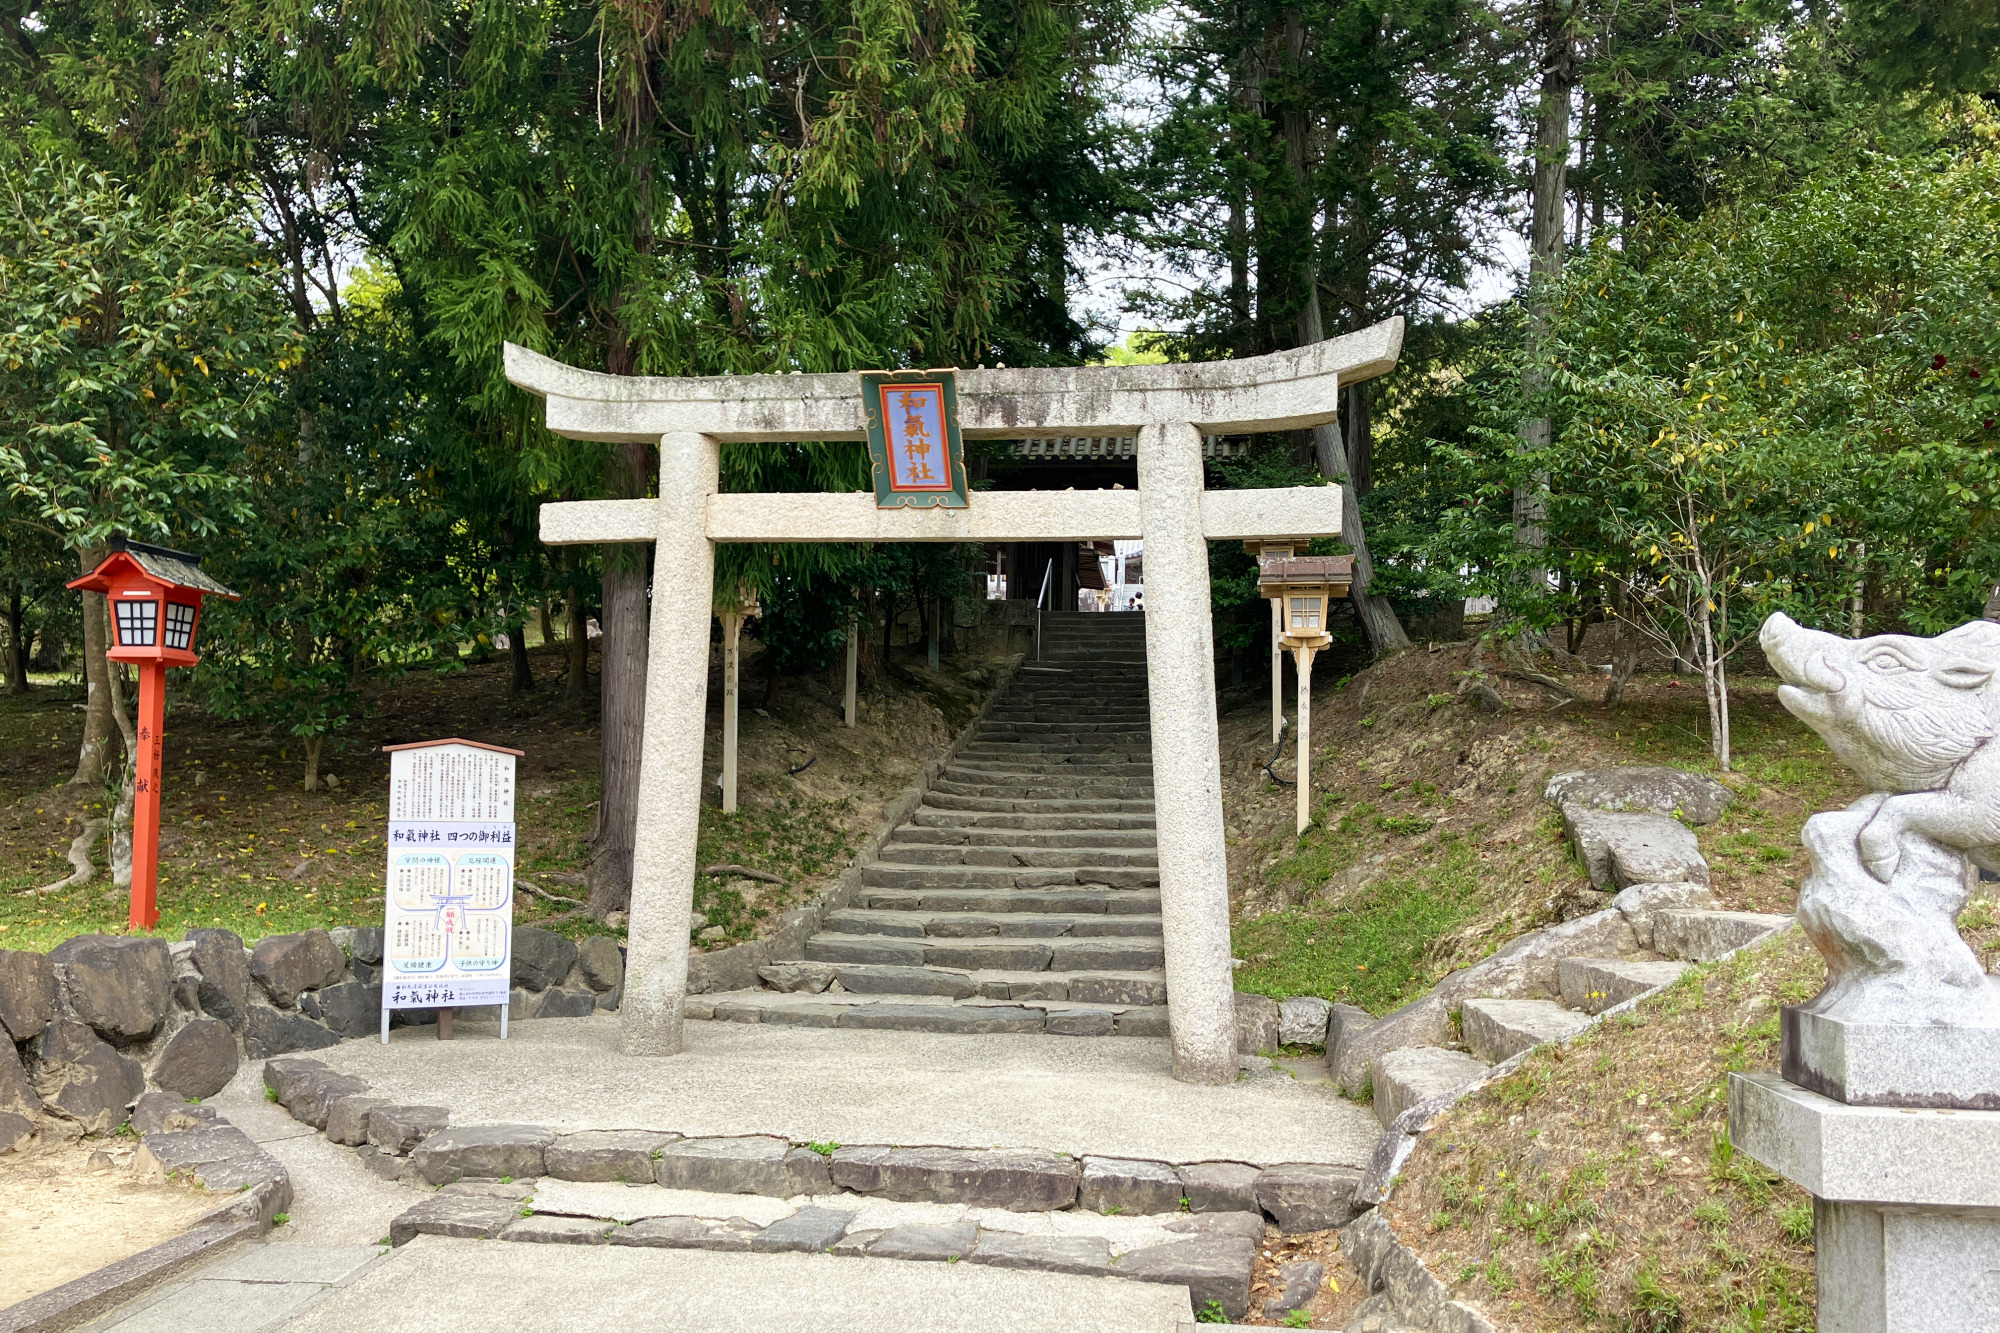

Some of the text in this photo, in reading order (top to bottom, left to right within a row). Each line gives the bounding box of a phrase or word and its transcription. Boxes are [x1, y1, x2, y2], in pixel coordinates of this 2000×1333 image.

[898, 391, 935, 483] 和氣神社
[137, 726, 150, 793] 奉献
[393, 829, 512, 843] 和氣神社 四つの御利益
[446, 907, 455, 934] 一願成就
[460, 959, 498, 967] 子供の守り神
[392, 989, 455, 1004] 和氣神社
